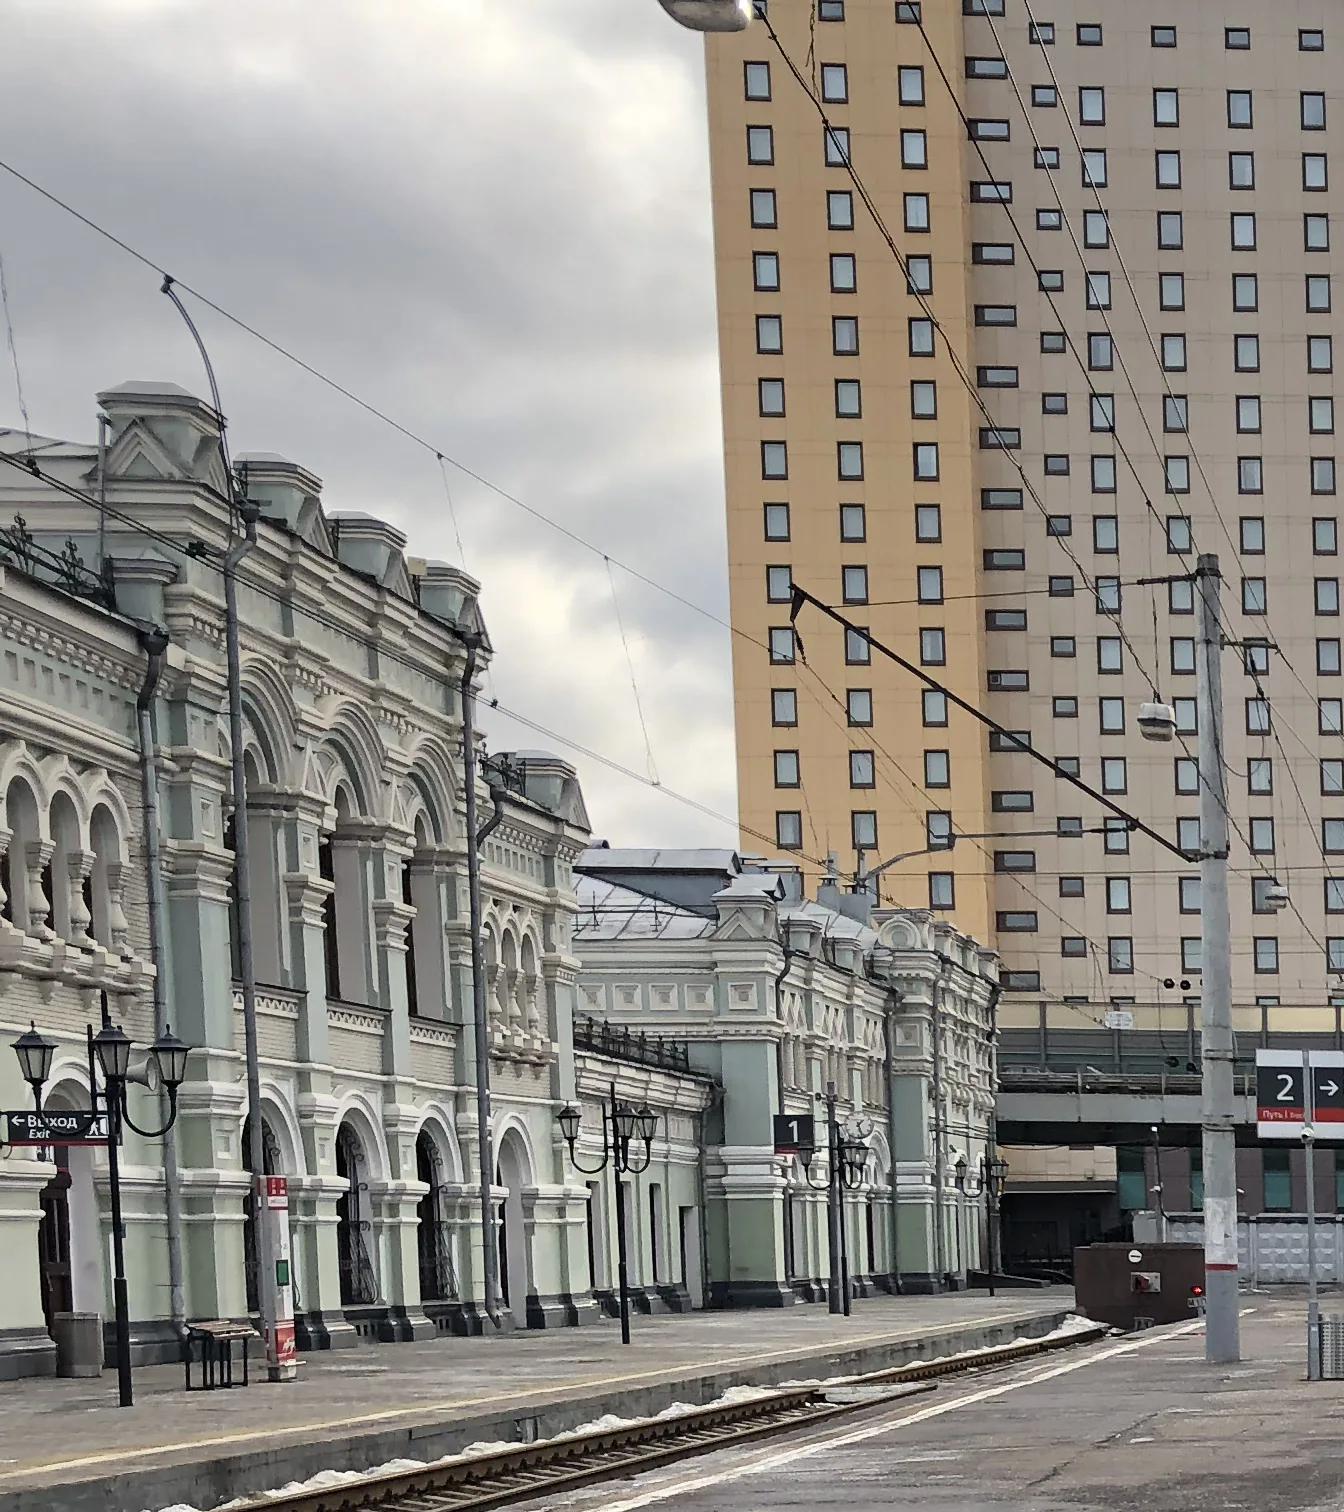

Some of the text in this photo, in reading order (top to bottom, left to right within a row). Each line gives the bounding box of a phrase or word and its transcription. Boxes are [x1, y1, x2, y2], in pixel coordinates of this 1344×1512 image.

[1276, 1074, 1294, 1101] 2
[28, 1128, 51, 1139] Exit
[788, 1120, 799, 1143] 1
